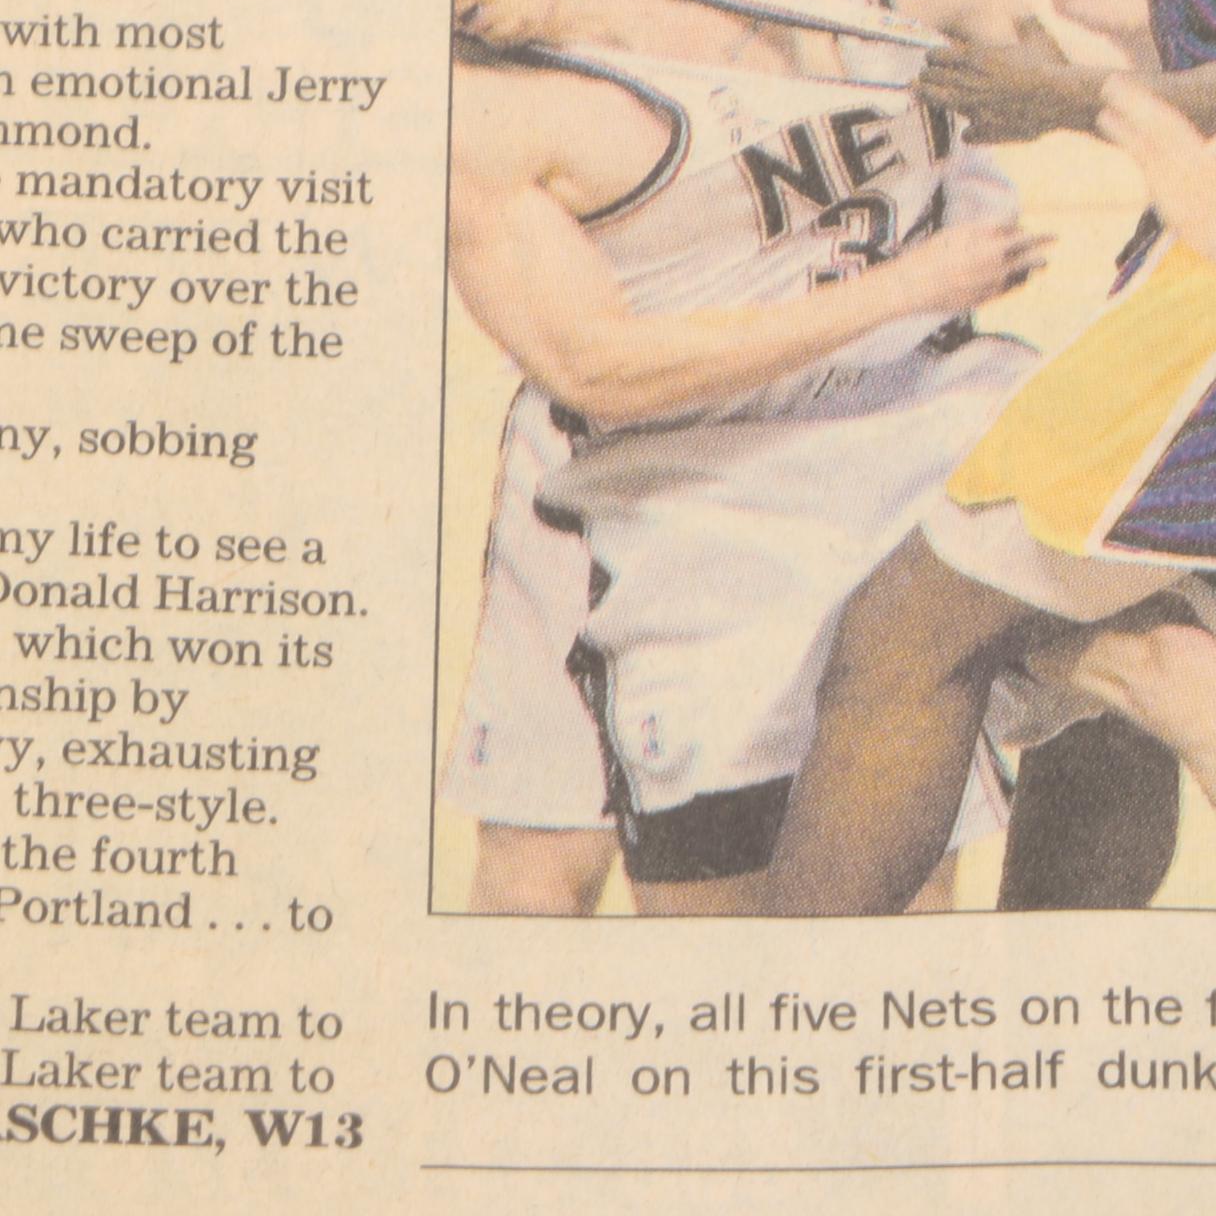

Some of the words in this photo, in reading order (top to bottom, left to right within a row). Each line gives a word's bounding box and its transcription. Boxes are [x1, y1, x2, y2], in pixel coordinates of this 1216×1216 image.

[0, 13, 100, 47] with
[116, 17, 224, 49] most
[31, 66, 252, 100] emotional
[267, 67, 387, 111] Jerry
[15, 166, 263, 210] mandatory
[277, 170, 373, 205] visit
[0, 212, 86, 248] who
[102, 218, 259, 255] carried
[276, 219, 347, 255] the
[0, 264, 156, 311] victory
[170, 278, 271, 305] over
[286, 271, 358, 306] the
[60, 325, 197, 364] sweep
[212, 320, 257, 356] of
[271, 322, 343, 358] the
[79, 420, 258, 468] sobbing
[69, 521, 140, 558] life
[156, 526, 200, 560] to
[216, 536, 286, 563] see
[302, 539, 326, 564] a
[154, 575, 367, 616] Harrison.
[14, 624, 153, 662] which
[168, 637, 263, 667] won
[278, 634, 332, 668] its
[131, 678, 189, 725] by
[62, 731, 320, 782] exhausting
[14, 782, 278, 831] three-style.
[2, 834, 76, 872] the
[91, 837, 239, 877] fourth
[288, 897, 333, 932] to
[10, 994, 151, 1036] Laker
[166, 1002, 281, 1039] team
[298, 1005, 342, 1040] to
[430, 991, 469, 1030] In
[494, 993, 663, 1040] theory,
[690, 992, 744, 1032] all
[770, 993, 856, 1031] five
[883, 990, 996, 1030] Nets
[1021, 996, 1079, 1025] on
[1103, 986, 1182, 1025] the
[0, 1049, 141, 1090] Laker
[158, 1056, 272, 1092] team
[290, 1059, 334, 1093] to
[632, 1066, 689, 1095] on
[726, 1056, 819, 1095] this
[855, 1050, 1065, 1095] first-half
[244, 1110, 363, 1149] W13
